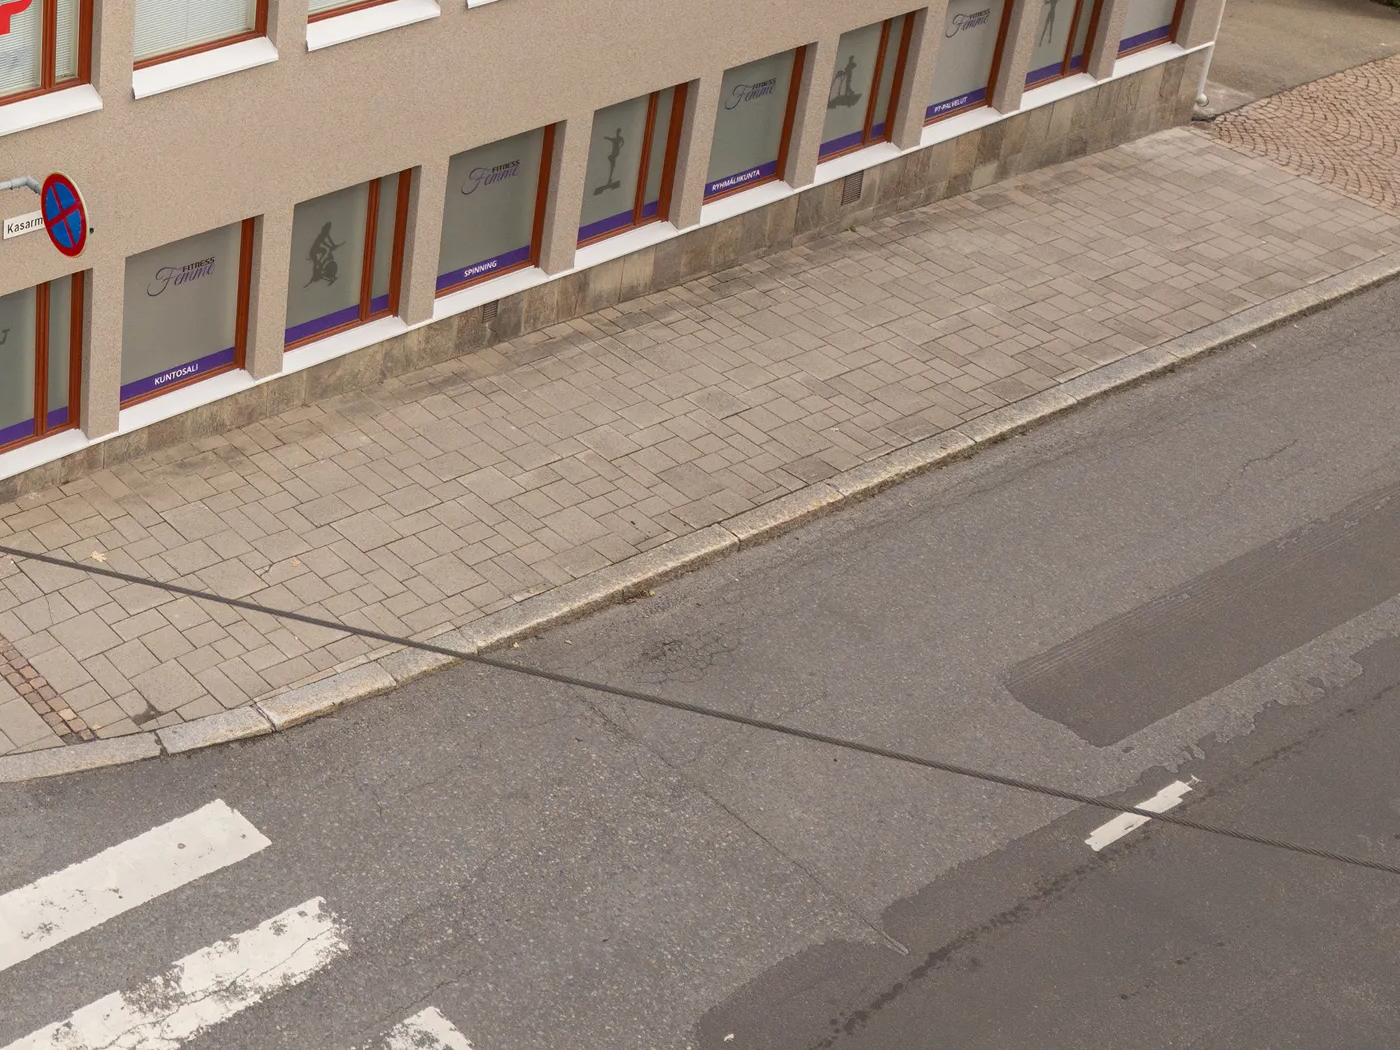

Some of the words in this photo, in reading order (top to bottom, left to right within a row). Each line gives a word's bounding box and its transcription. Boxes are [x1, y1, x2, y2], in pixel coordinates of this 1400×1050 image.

[969, 8, 991, 19] FITNESS
[945, 13, 989, 38] Femme
[752, 77, 777, 91] FITNESS
[725, 83, 775, 110] Femme
[933, 96, 968, 114] PT-PALVELUT
[491, 159, 521, 173] FITNESS
[461, 166, 520, 195] Femme
[711, 169, 760, 192] RYHMÄLIIKUNTA
[182, 256, 215, 273] FITNESS
[463, 260, 498, 278] SPINNING
[146, 263, 216, 297] Femme
[153, 363, 199, 386] KUNTOSALI
